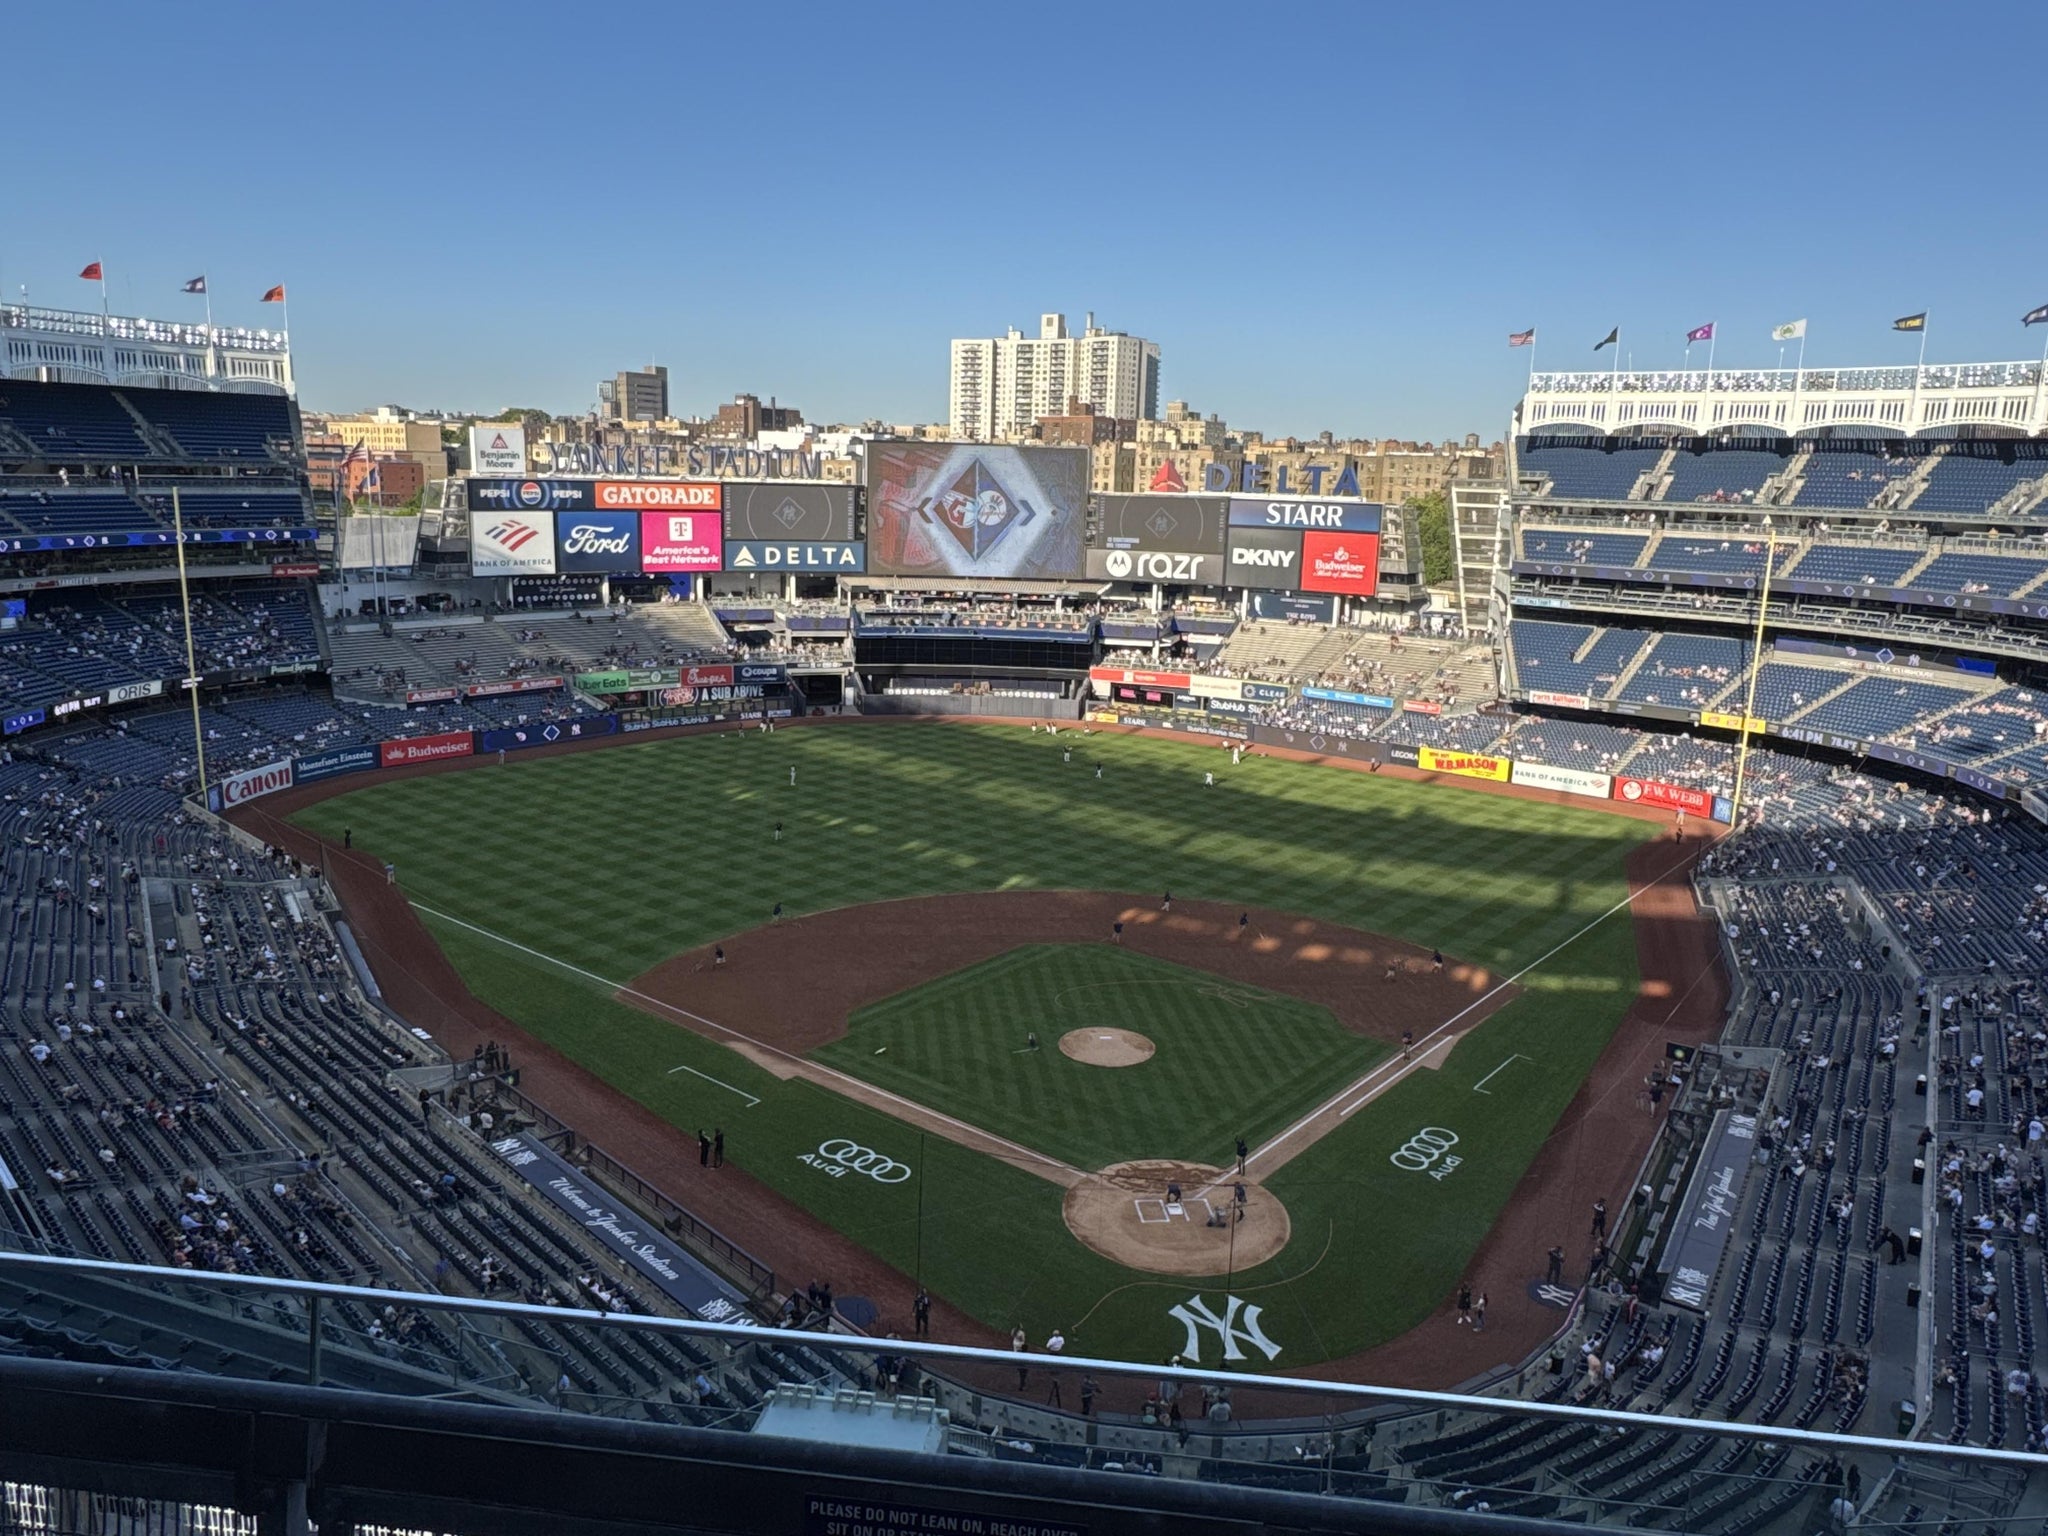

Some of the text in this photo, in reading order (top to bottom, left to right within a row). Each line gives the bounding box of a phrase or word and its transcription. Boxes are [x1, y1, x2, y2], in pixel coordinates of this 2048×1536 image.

[480, 449, 521, 462] Benjamin
[546, 442, 822, 478] YANKEE STADIUM
[486, 459, 516, 471] Moore
[1204, 463, 1361, 496] DELTA
[480, 489, 510, 499] PEPSI
[552, 489, 582, 499] PEPSI
[602, 486, 716, 506] GATORADE
[1266, 502, 1343, 527] STARR
[565, 525, 630, 554] Ford
[652, 545, 710, 555] America's
[765, 547, 856, 565] DELTA
[1232, 548, 1295, 567] DKNY
[474, 558, 553, 568] BANK OF AMERICA
[644, 554, 719, 564] Best Network
[1137, 553, 1204, 580] razr
[1315, 559, 1366, 574] Budweiser
[752, 667, 778, 677] coupa
[118, 683, 151, 700] ORIS
[579, 680, 602, 690] Uber
[602, 678, 627, 688] Eats
[702, 689, 709, 701] A
[711, 687, 731, 700] SUB
[734, 685, 765, 698] ABOVE
[1210, 699, 1246, 712] StubHub
[624, 722, 651, 732] StubHub
[652, 719, 679, 728] StubHub
[681, 715, 709, 725] StubHub
[740, 711, 762, 720] STARR
[1123, 716, 1147, 726] STARR
[1782, 727, 1804, 741] 6:41
[1806, 731, 1824, 744] PM
[408, 741, 471, 758] Budweiser
[298, 757, 339, 772] Montefiore
[340, 750, 373, 763] Einstein
[225, 767, 290, 803] Canon
[1515, 770, 1536, 778] BANK
[1550, 775, 1588, 787] AMERICA
[1668, 788, 1704, 807] WEBB
[796, 1153, 850, 1178] Audi
[1428, 1154, 1464, 1182] Audi
[548, 1176, 680, 1280] Welcome to Yankee Stadium
[1168, 1293, 1283, 1363] NY
[811, 1501, 862, 1520] PLEASE
[865, 1507, 884, 1522] DO
[888, 1510, 918, 1526] NOT
[921, 1514, 957, 1531] LEAN
[962, 1519, 987, 1535] ON,
[990, 1522, 1037, 1536] REACH
[826, 1522, 849, 1536] SIT
[853, 1525, 873, 1536] ON
